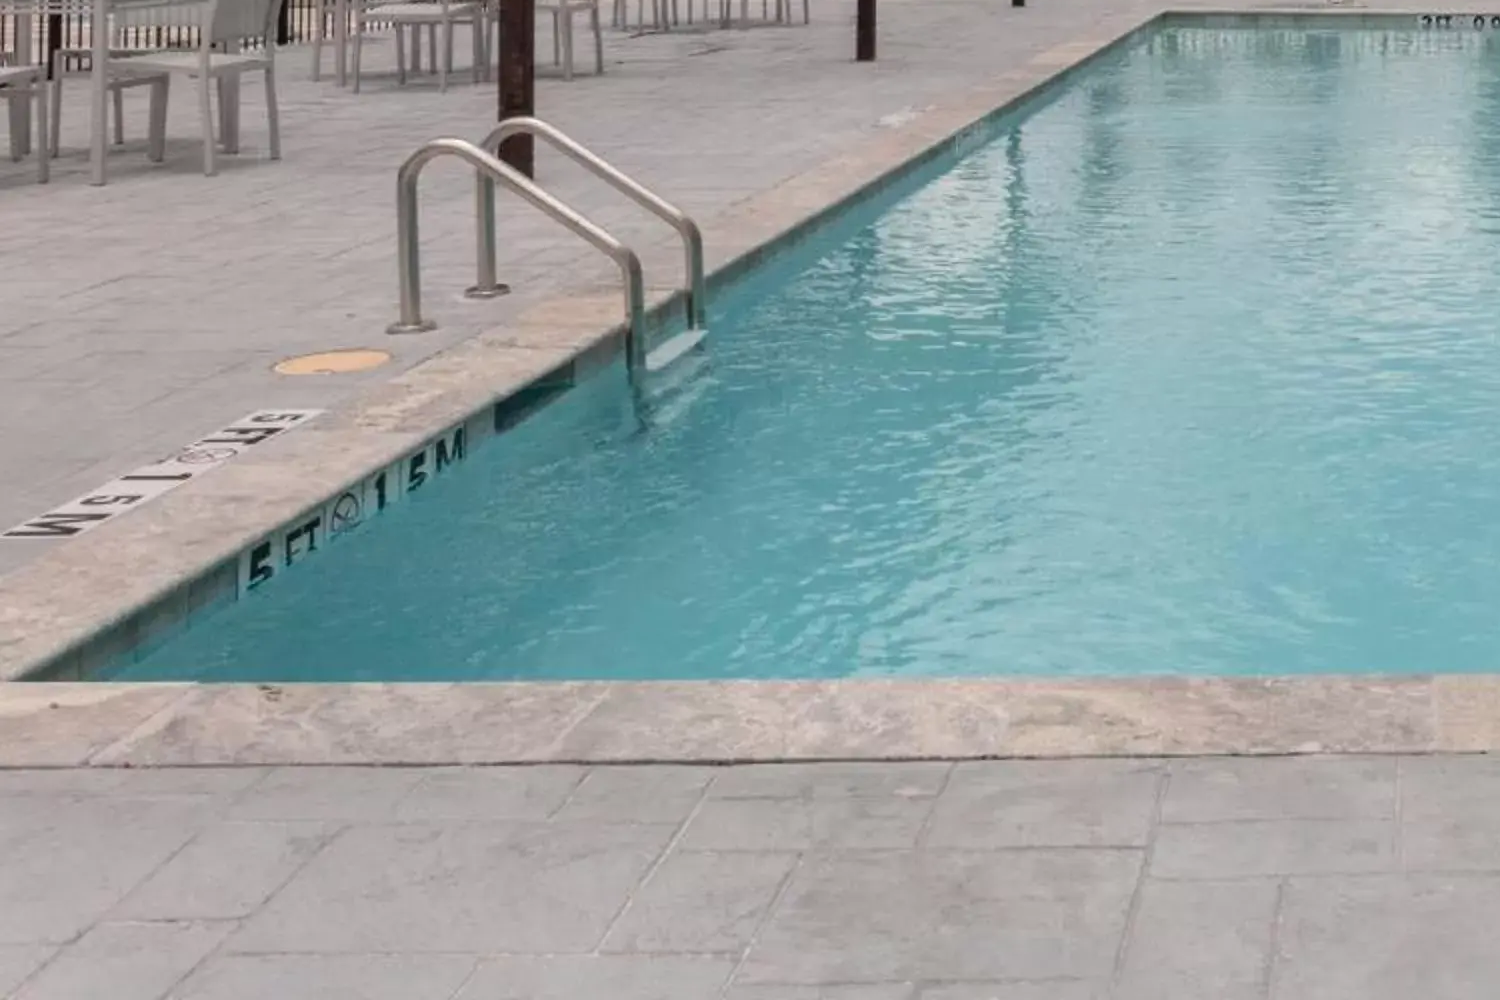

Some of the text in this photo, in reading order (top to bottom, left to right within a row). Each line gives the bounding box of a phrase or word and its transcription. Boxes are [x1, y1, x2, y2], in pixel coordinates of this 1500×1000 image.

[79, 495, 145, 505] 5
[247, 426, 463, 591] 5 FT 1 5 M
[2, 513, 113, 537] M
